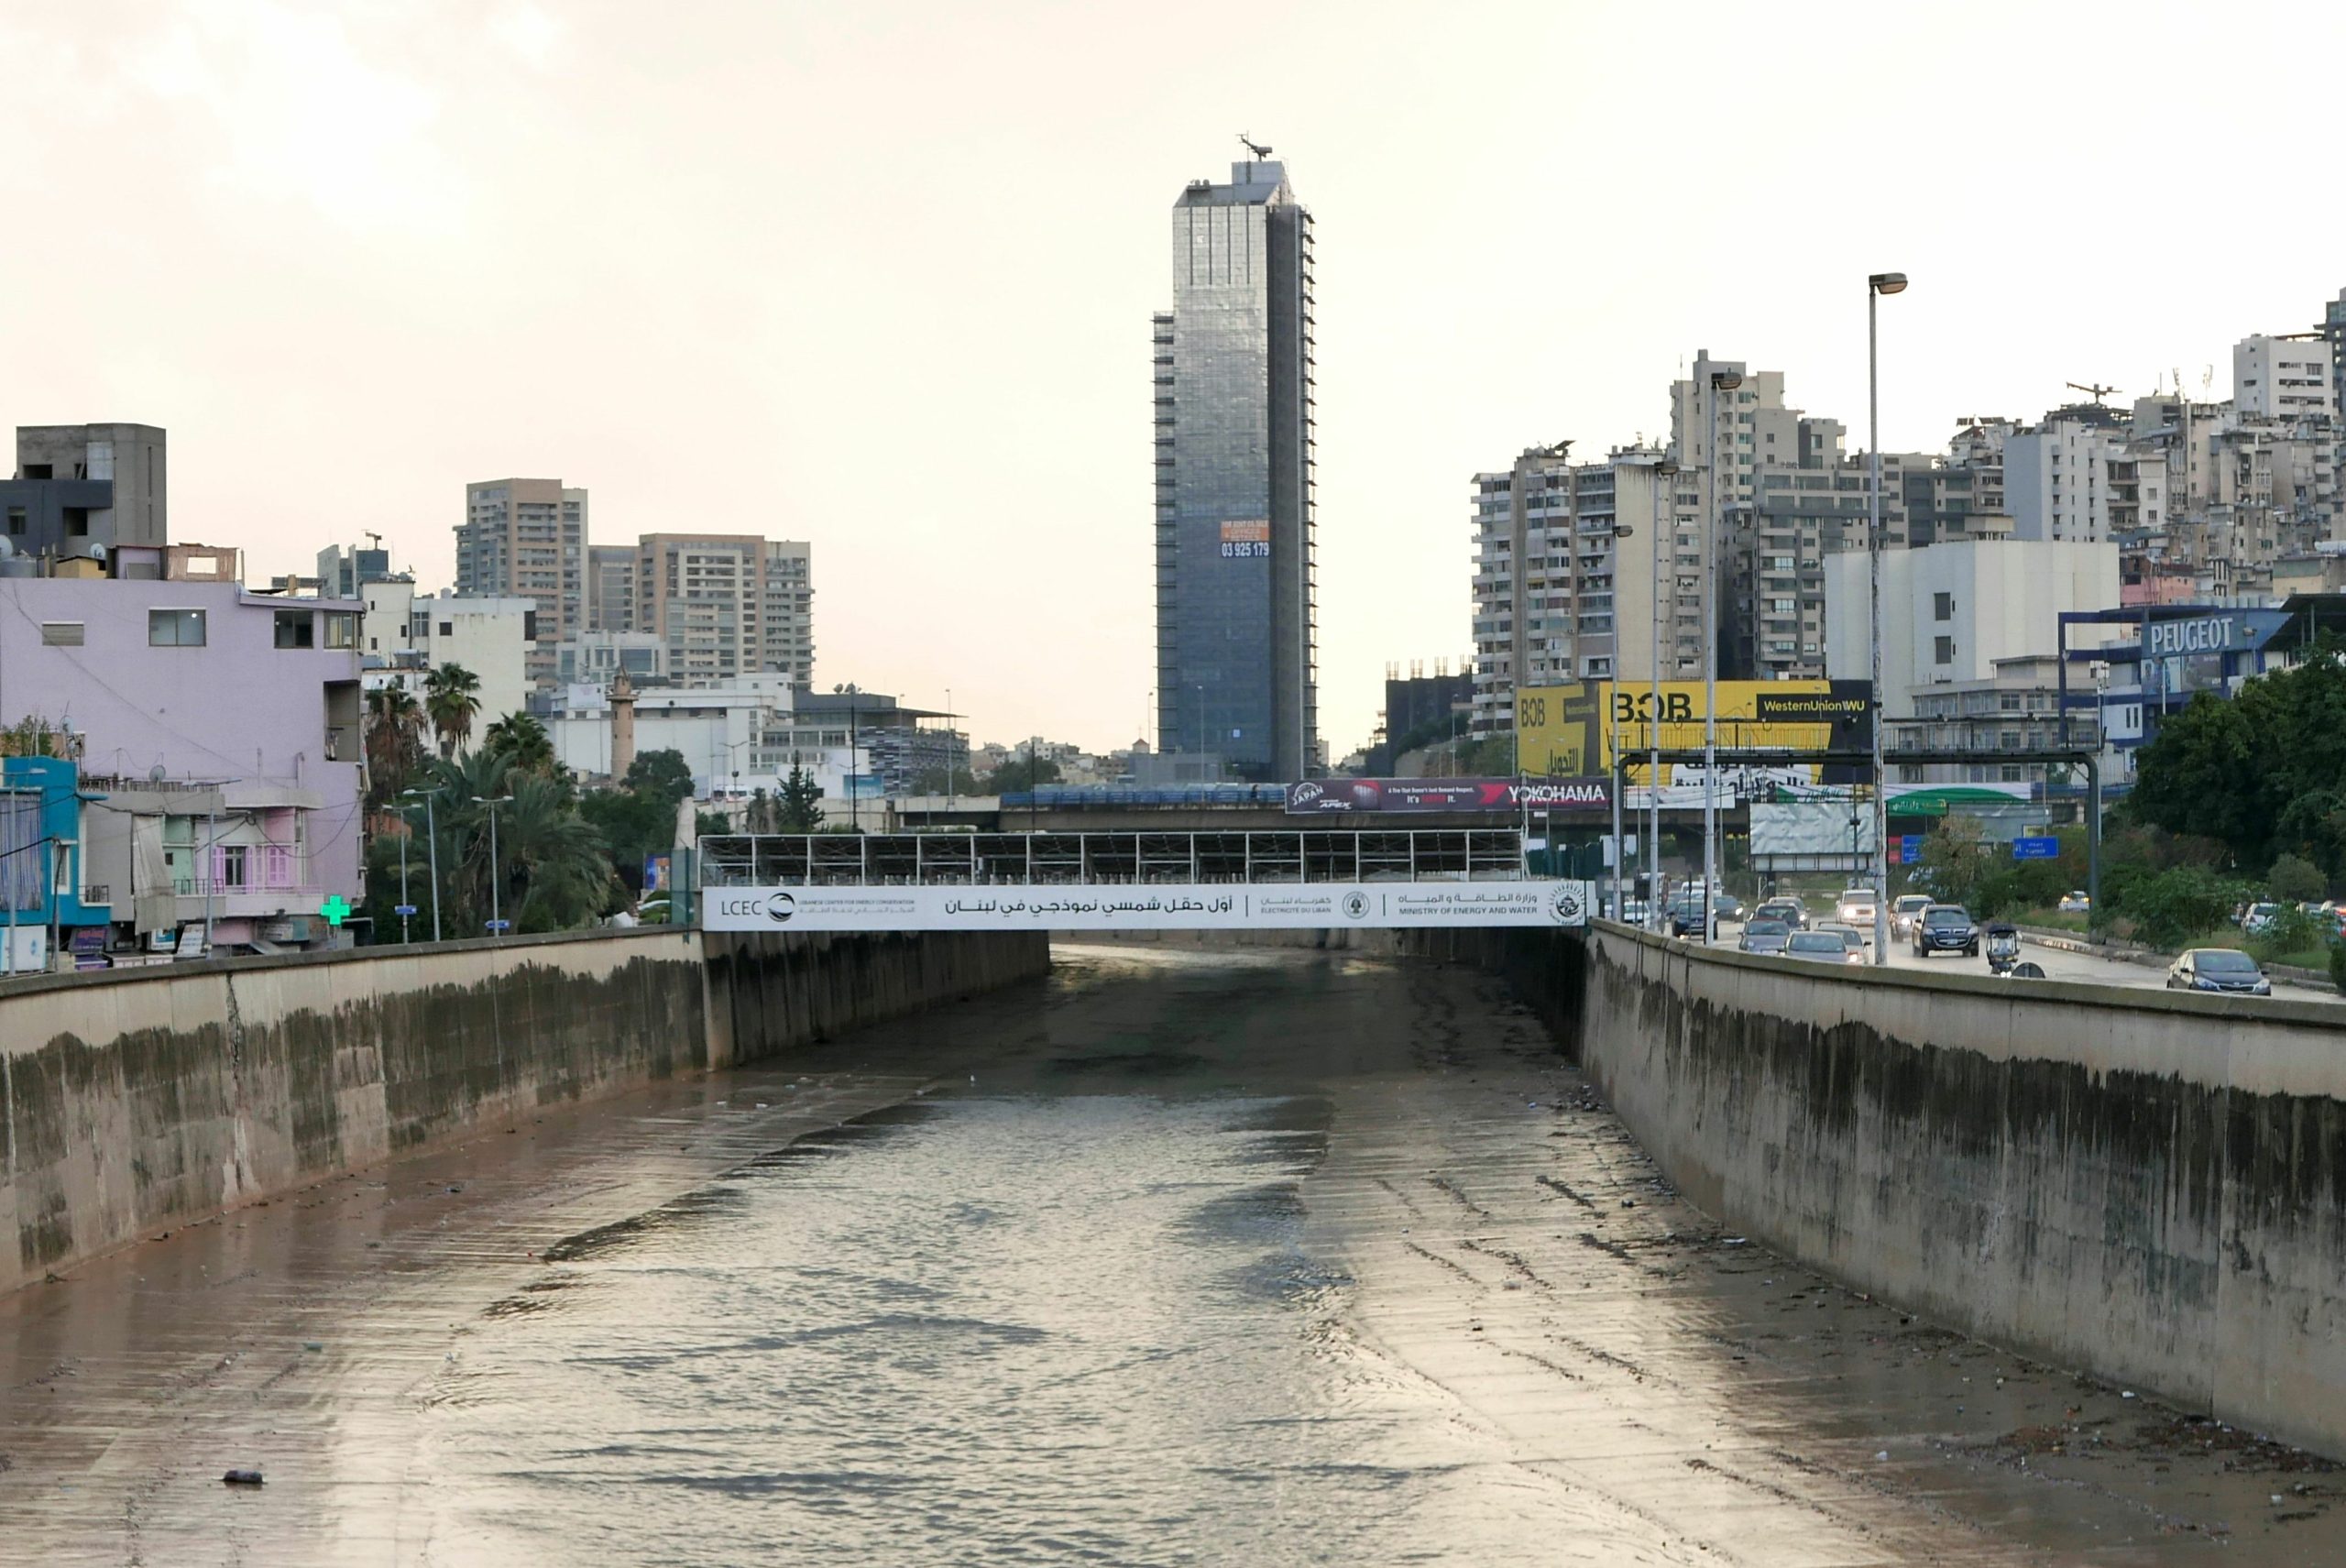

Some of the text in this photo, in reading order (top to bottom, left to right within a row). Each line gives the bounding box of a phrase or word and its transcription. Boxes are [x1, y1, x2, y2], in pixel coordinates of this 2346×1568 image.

[1222, 542, 1270, 557] 03 925 179
[2151, 618, 2233, 653] PEUGEOT
[1764, 700, 1842, 711] WesternUnion
[1291, 785, 1324, 806] JAPAN
[1508, 784, 1606, 803] YOKOHAMA
[1102, 896, 1160, 916] شمسي
[1164, 897, 1203, 913] حقل
[1398, 894, 1444, 905] المياه
[1454, 894, 1513, 903] الطاقة
[1515, 894, 1537, 904] وزارة
[721, 901, 762, 916] LCEC
[945, 900, 996, 914] لبنان
[1000, 899, 1025, 917] في
[1030, 899, 1097, 917] نموذجي
[1508, 906, 1537, 915] WATER
